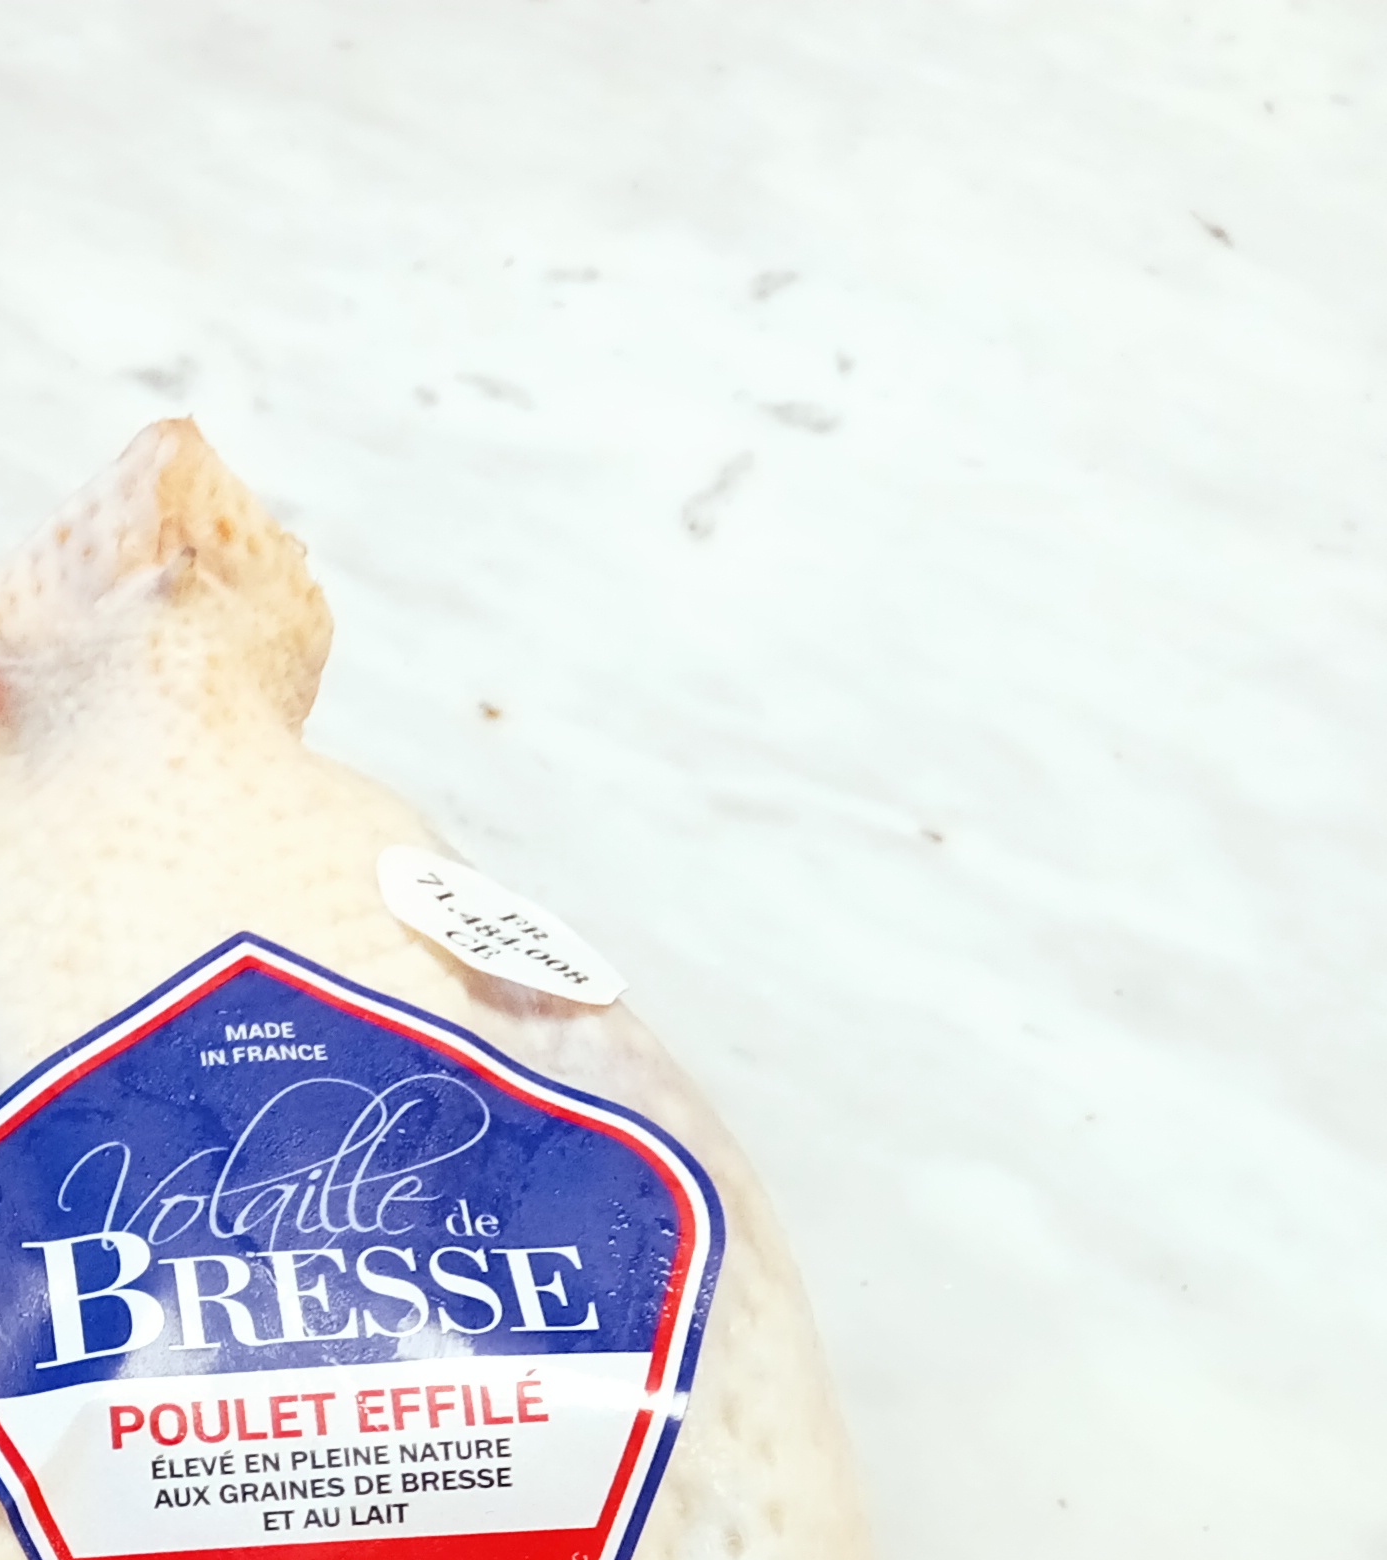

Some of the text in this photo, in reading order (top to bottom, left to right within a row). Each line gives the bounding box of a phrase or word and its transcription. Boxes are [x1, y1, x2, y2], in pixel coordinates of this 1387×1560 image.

[416, 871, 590, 985] 71.484.008
[445, 930, 502, 960] CE
[498, 912, 550, 942] FR
[225, 1021, 296, 1042] MADE
[200, 1044, 328, 1067] IN FRANCE
[59, 1075, 501, 1269] Volaille de
[22, 1231, 599, 1370] BRESSE
[109, 1370, 549, 1450] POULET EFFILÉ
[151, 1437, 513, 1480] ÉLEVÉ EN PLEINE NATURE
[153, 1467, 513, 1510] AUX GRAINES DE BRESSE
[262, 1503, 409, 1531] ET AU LAIT
